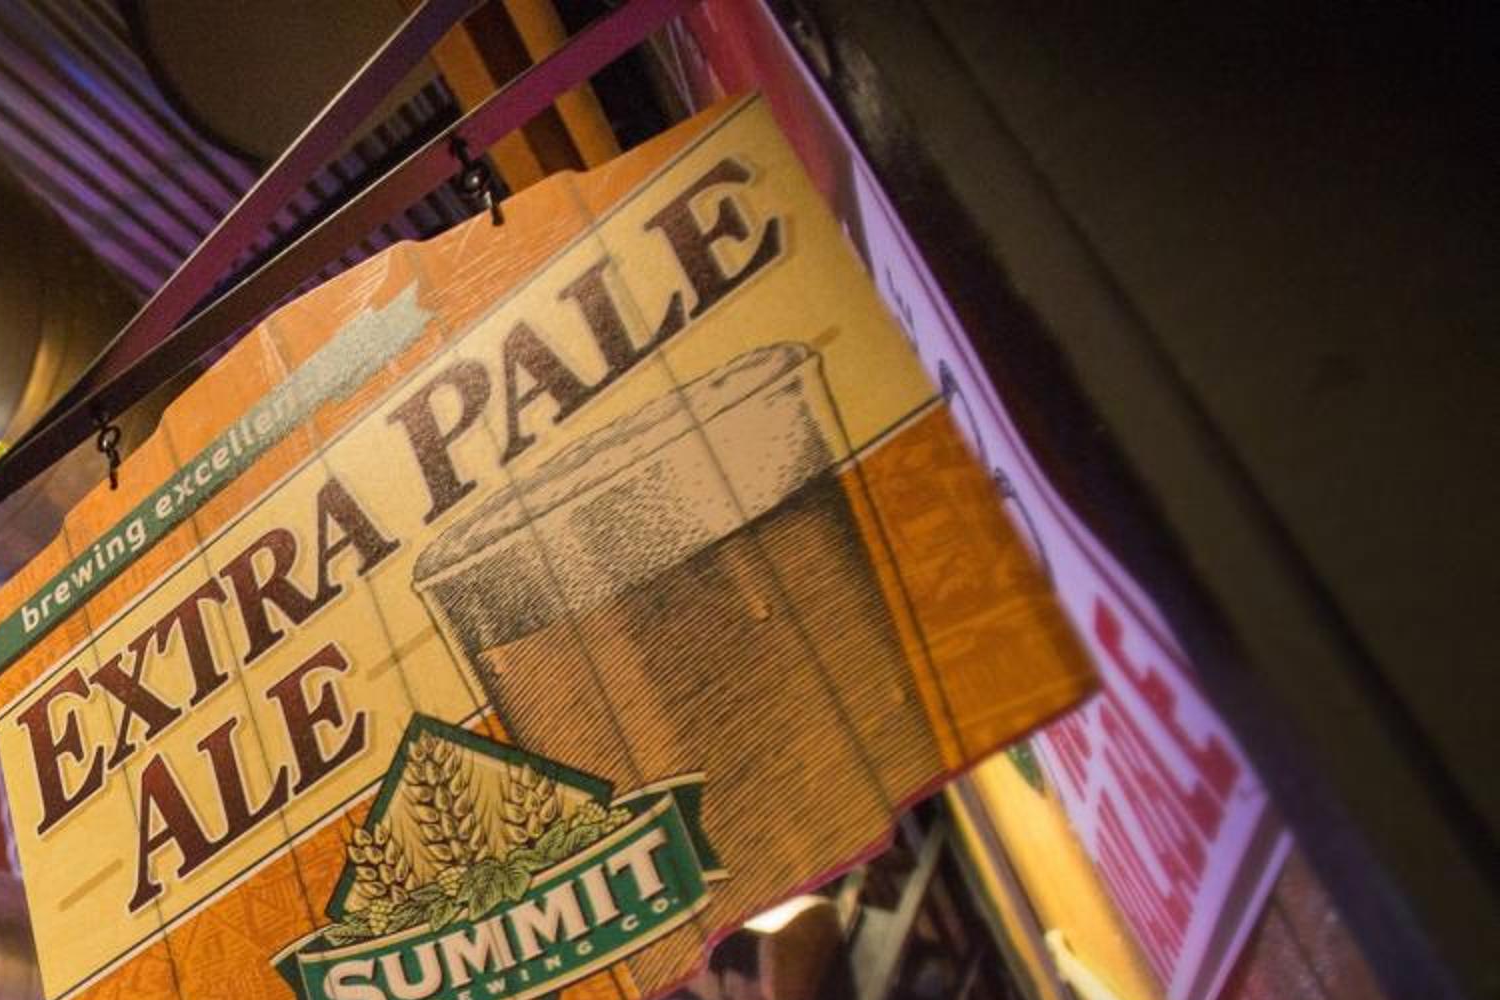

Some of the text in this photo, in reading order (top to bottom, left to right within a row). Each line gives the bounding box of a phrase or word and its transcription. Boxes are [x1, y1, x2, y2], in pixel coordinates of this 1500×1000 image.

[16, 477, 401, 836] EXTRA
[387, 158, 783, 526] PALE
[20, 517, 147, 634] brewing
[128, 643, 367, 912] ALE
